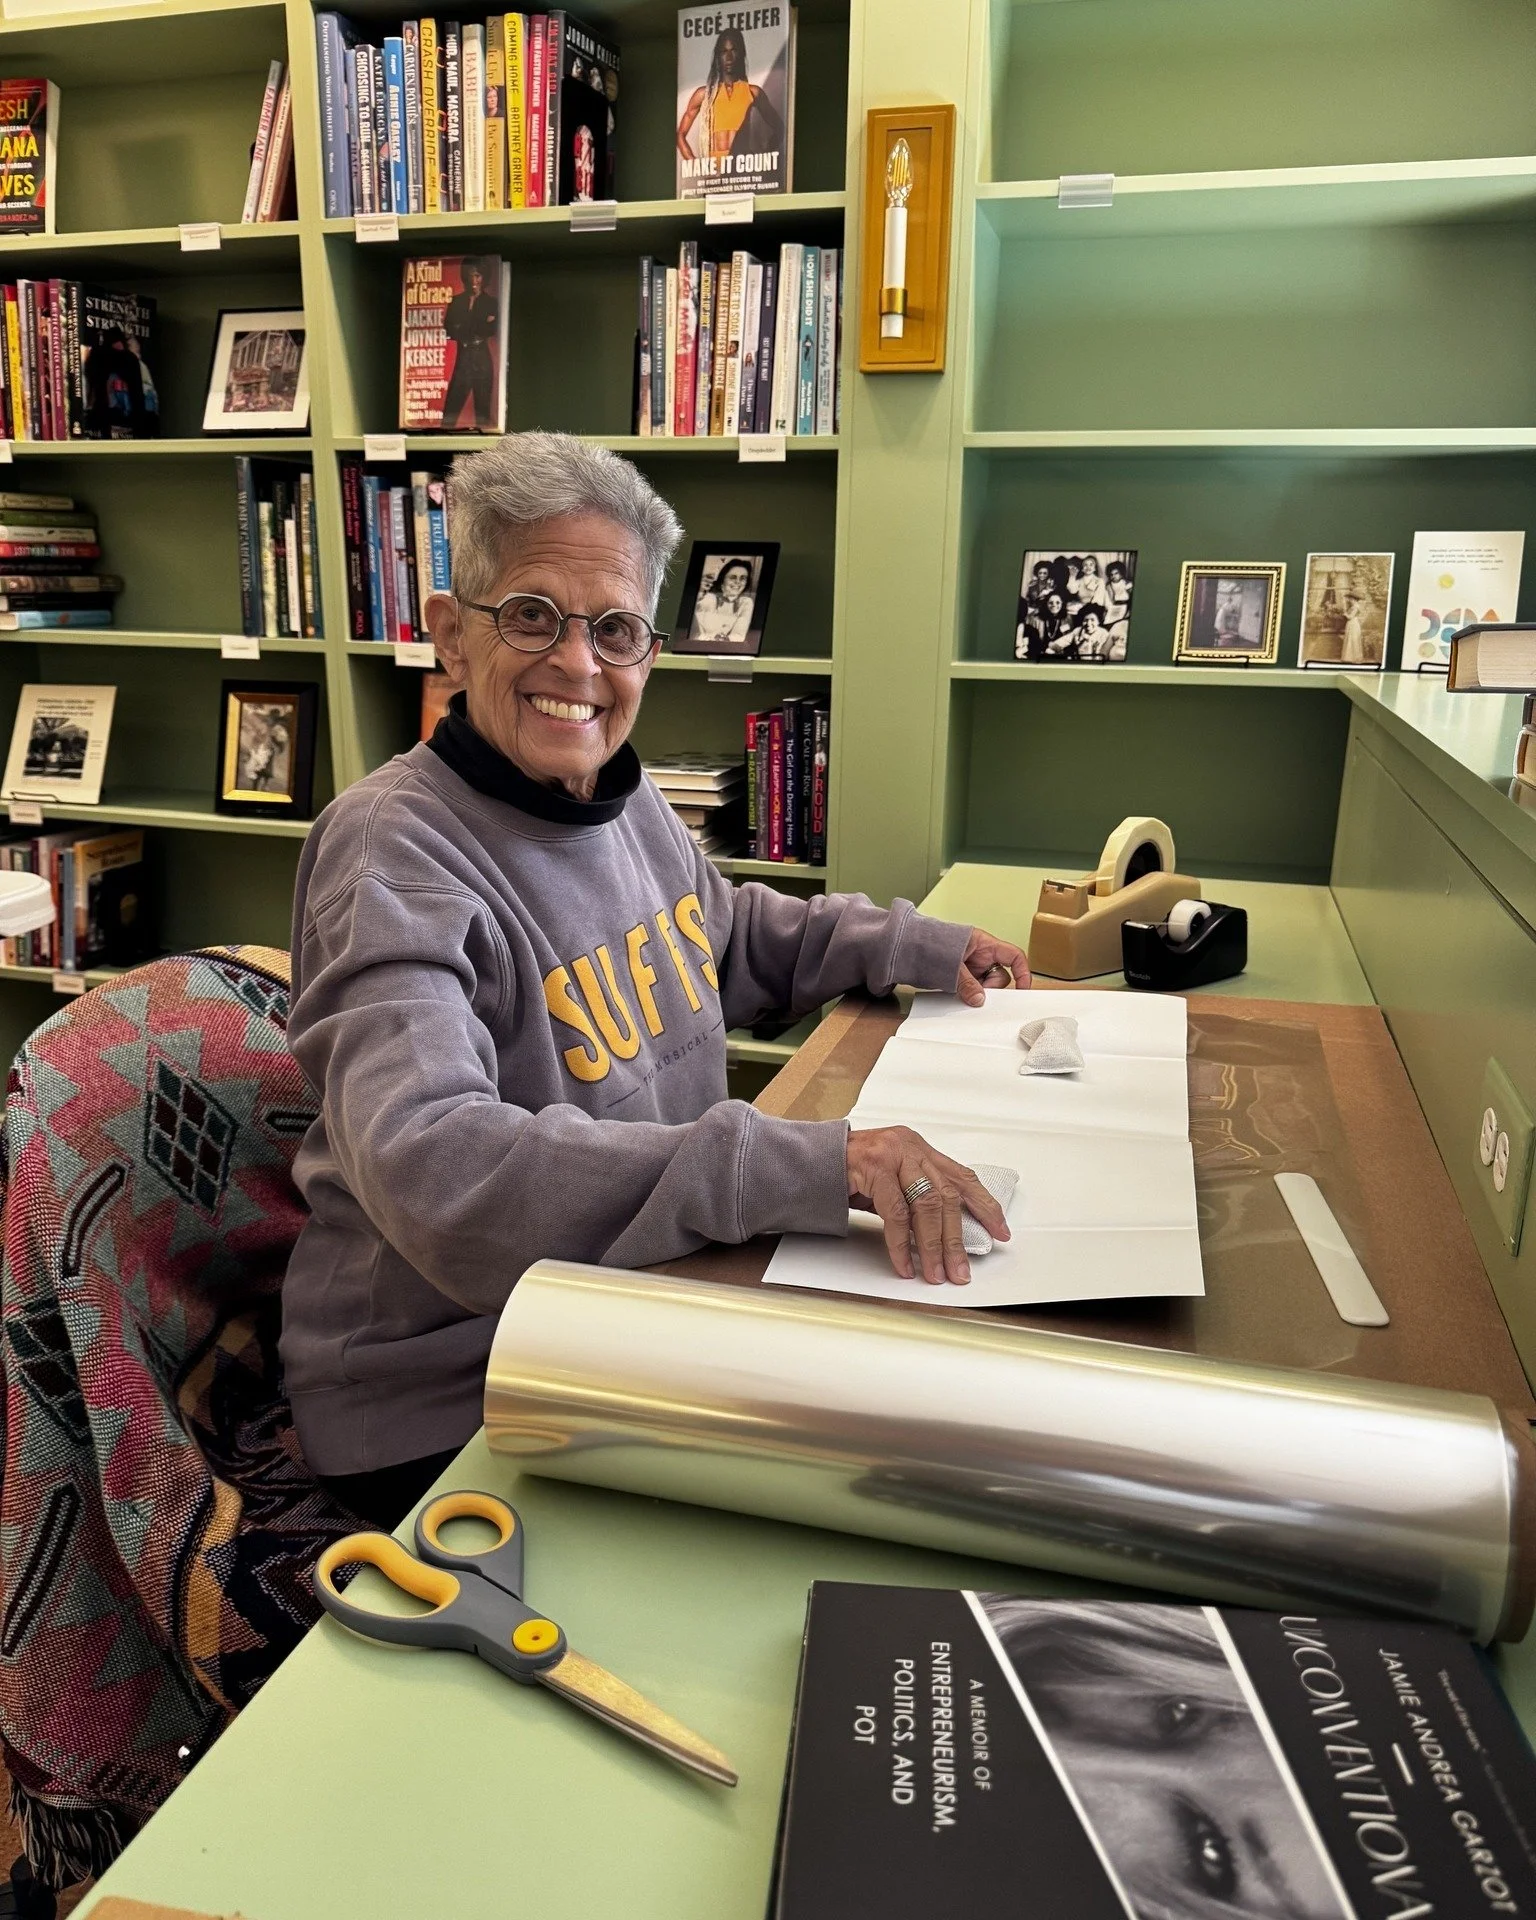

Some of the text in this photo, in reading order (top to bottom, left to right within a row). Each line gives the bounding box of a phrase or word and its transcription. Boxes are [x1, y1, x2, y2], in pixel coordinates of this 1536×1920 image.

[566, 26, 595, 57] JORDAN
[683, 7, 780, 38] CECÉ TELFER
[321, 20, 331, 74] OUTSTANDING
[404, 44, 416, 86] CARMEN
[507, 21, 518, 94] COMING HOME
[532, 50, 542, 76] FASTER
[421, 25, 436, 166] CRASH OVERRIDE
[465, 52, 478, 97] BABE
[356, 51, 371, 145] CHOOSING TO RUN
[374, 55, 386, 141] KATIE LEDECKY
[447, 94, 459, 143] MASCARA
[254, 87, 276, 161] FARMER JANE
[389, 84, 401, 163] ANNIE OAKLEY
[530, 113, 540, 173] MAGGIE MERTENS
[453, 149, 461, 194] CATHERINE
[510, 106, 523, 193] BRITTNEY GRINER
[681, 151, 779, 178] MAKE IT COUNT
[407, 260, 442, 283] A Kind
[407, 283, 453, 304] of Grace
[805, 254, 815, 327] HOW SHE DID IT
[86, 296, 150, 320] STRENGTH
[731, 254, 742, 336] COURAGE TO SOAR
[86, 315, 150, 338] STRENGTH
[405, 309, 443, 327] JACKIE
[52, 326, 60, 363] CHATTO
[74, 349, 79, 358] TO
[405, 348, 445, 368] KERSEE
[715, 357, 726, 390] MUSCLE
[351, 467, 359, 510] Encyclopedia
[353, 512, 359, 520] of
[392, 493, 404, 542] MISTY
[432, 514, 445, 588] TRUE SPIRIT
[787, 770, 793, 778] on
[785, 793, 794, 822] Dancing
[813, 764, 824, 833] PROUD
[786, 824, 794, 845] Horse
[542, 892, 720, 1083] SUFFS
[1128, 971, 1151, 981] Scotch
[655, 1032, 708, 1072] MUSICAL
[854, 1705, 876, 1745] POT
[891, 1658, 915, 1806] POLITICS, AND
[931, 1642, 957, 1833] ENTREPRENEURISM,
[969, 1679, 991, 1791] A MEMOIR OF
[1379, 1648, 1421, 1707] JAMIE
[1406, 1712, 1463, 1801] ANDREA
[1451, 1810, 1518, 1913] GARZOT
